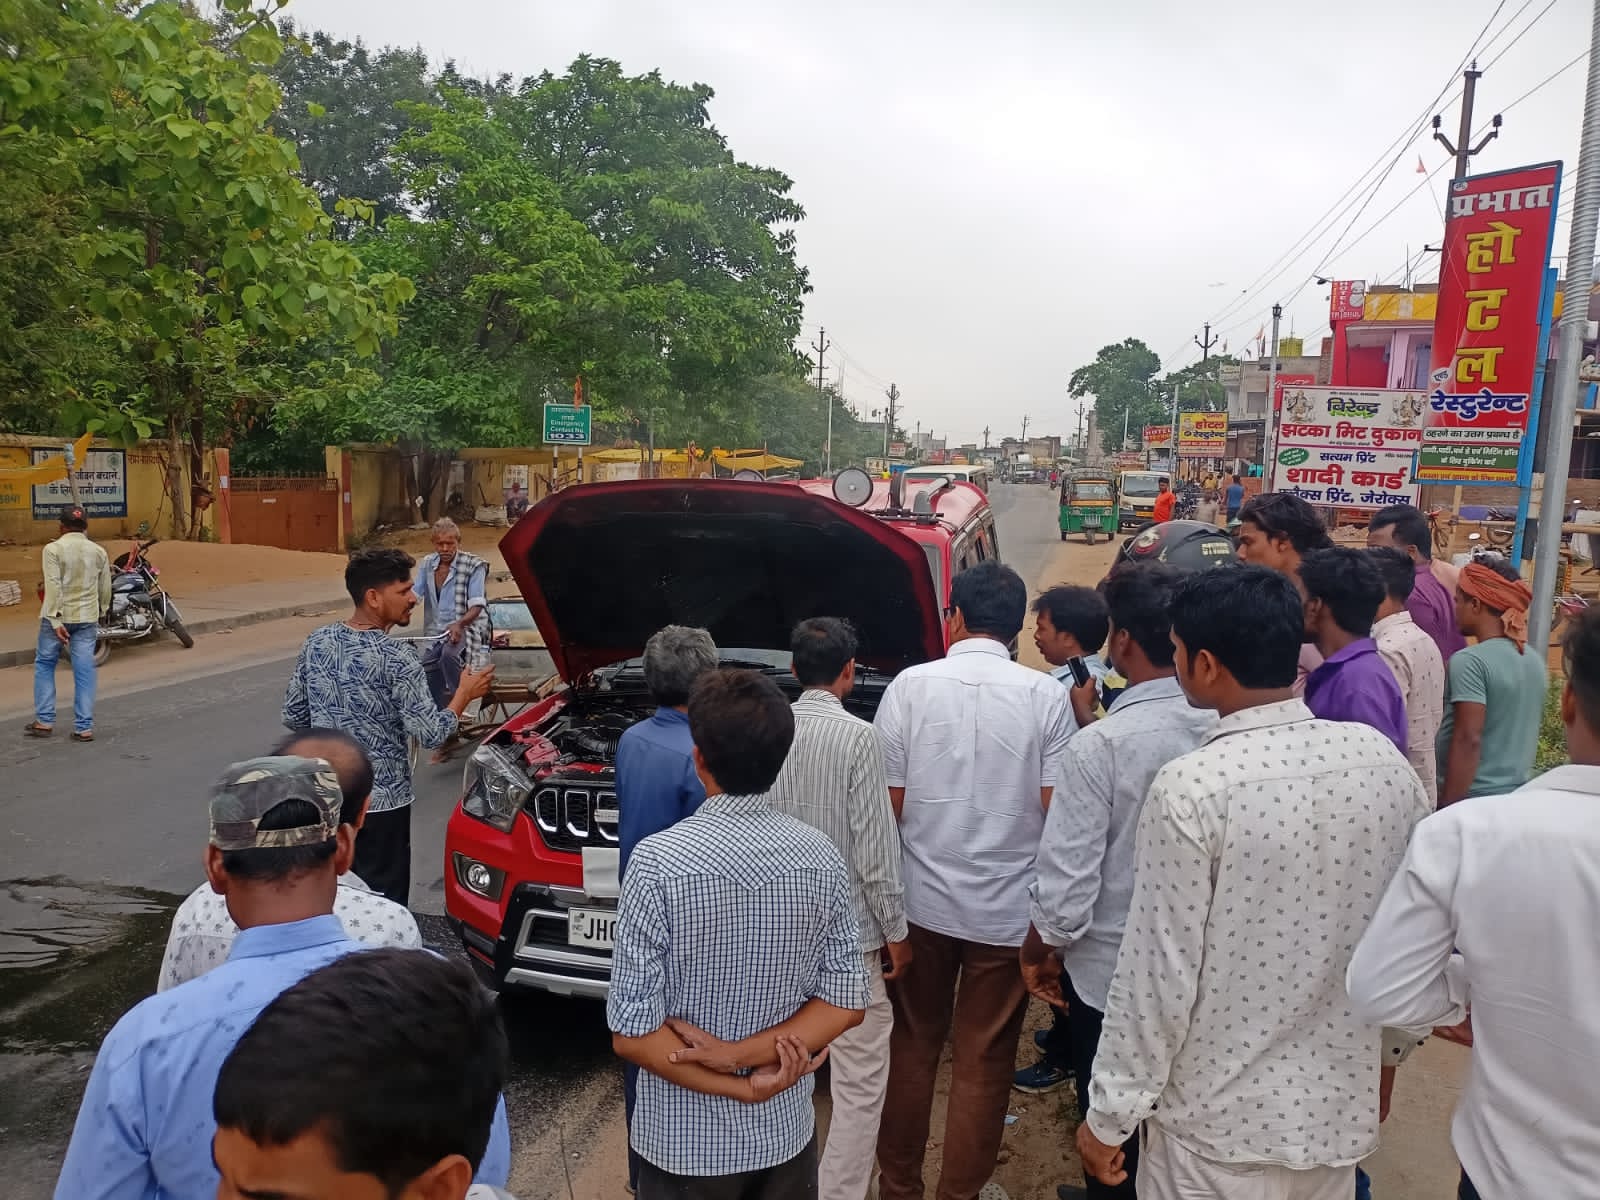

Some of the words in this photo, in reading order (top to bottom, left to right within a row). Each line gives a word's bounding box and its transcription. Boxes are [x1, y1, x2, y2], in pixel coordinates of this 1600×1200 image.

[1452, 184, 1555, 218] प्रभात
[1455, 221, 1523, 383] होटल
[1281, 424, 1331, 438] झटका
[1336, 421, 1368, 439] मिट
[1371, 427, 1422, 447] दुकान
[1320, 452, 1352, 462] सत्यम
[1286, 463, 1344, 485] शादी
[1351, 467, 1408, 489] कार्ड
